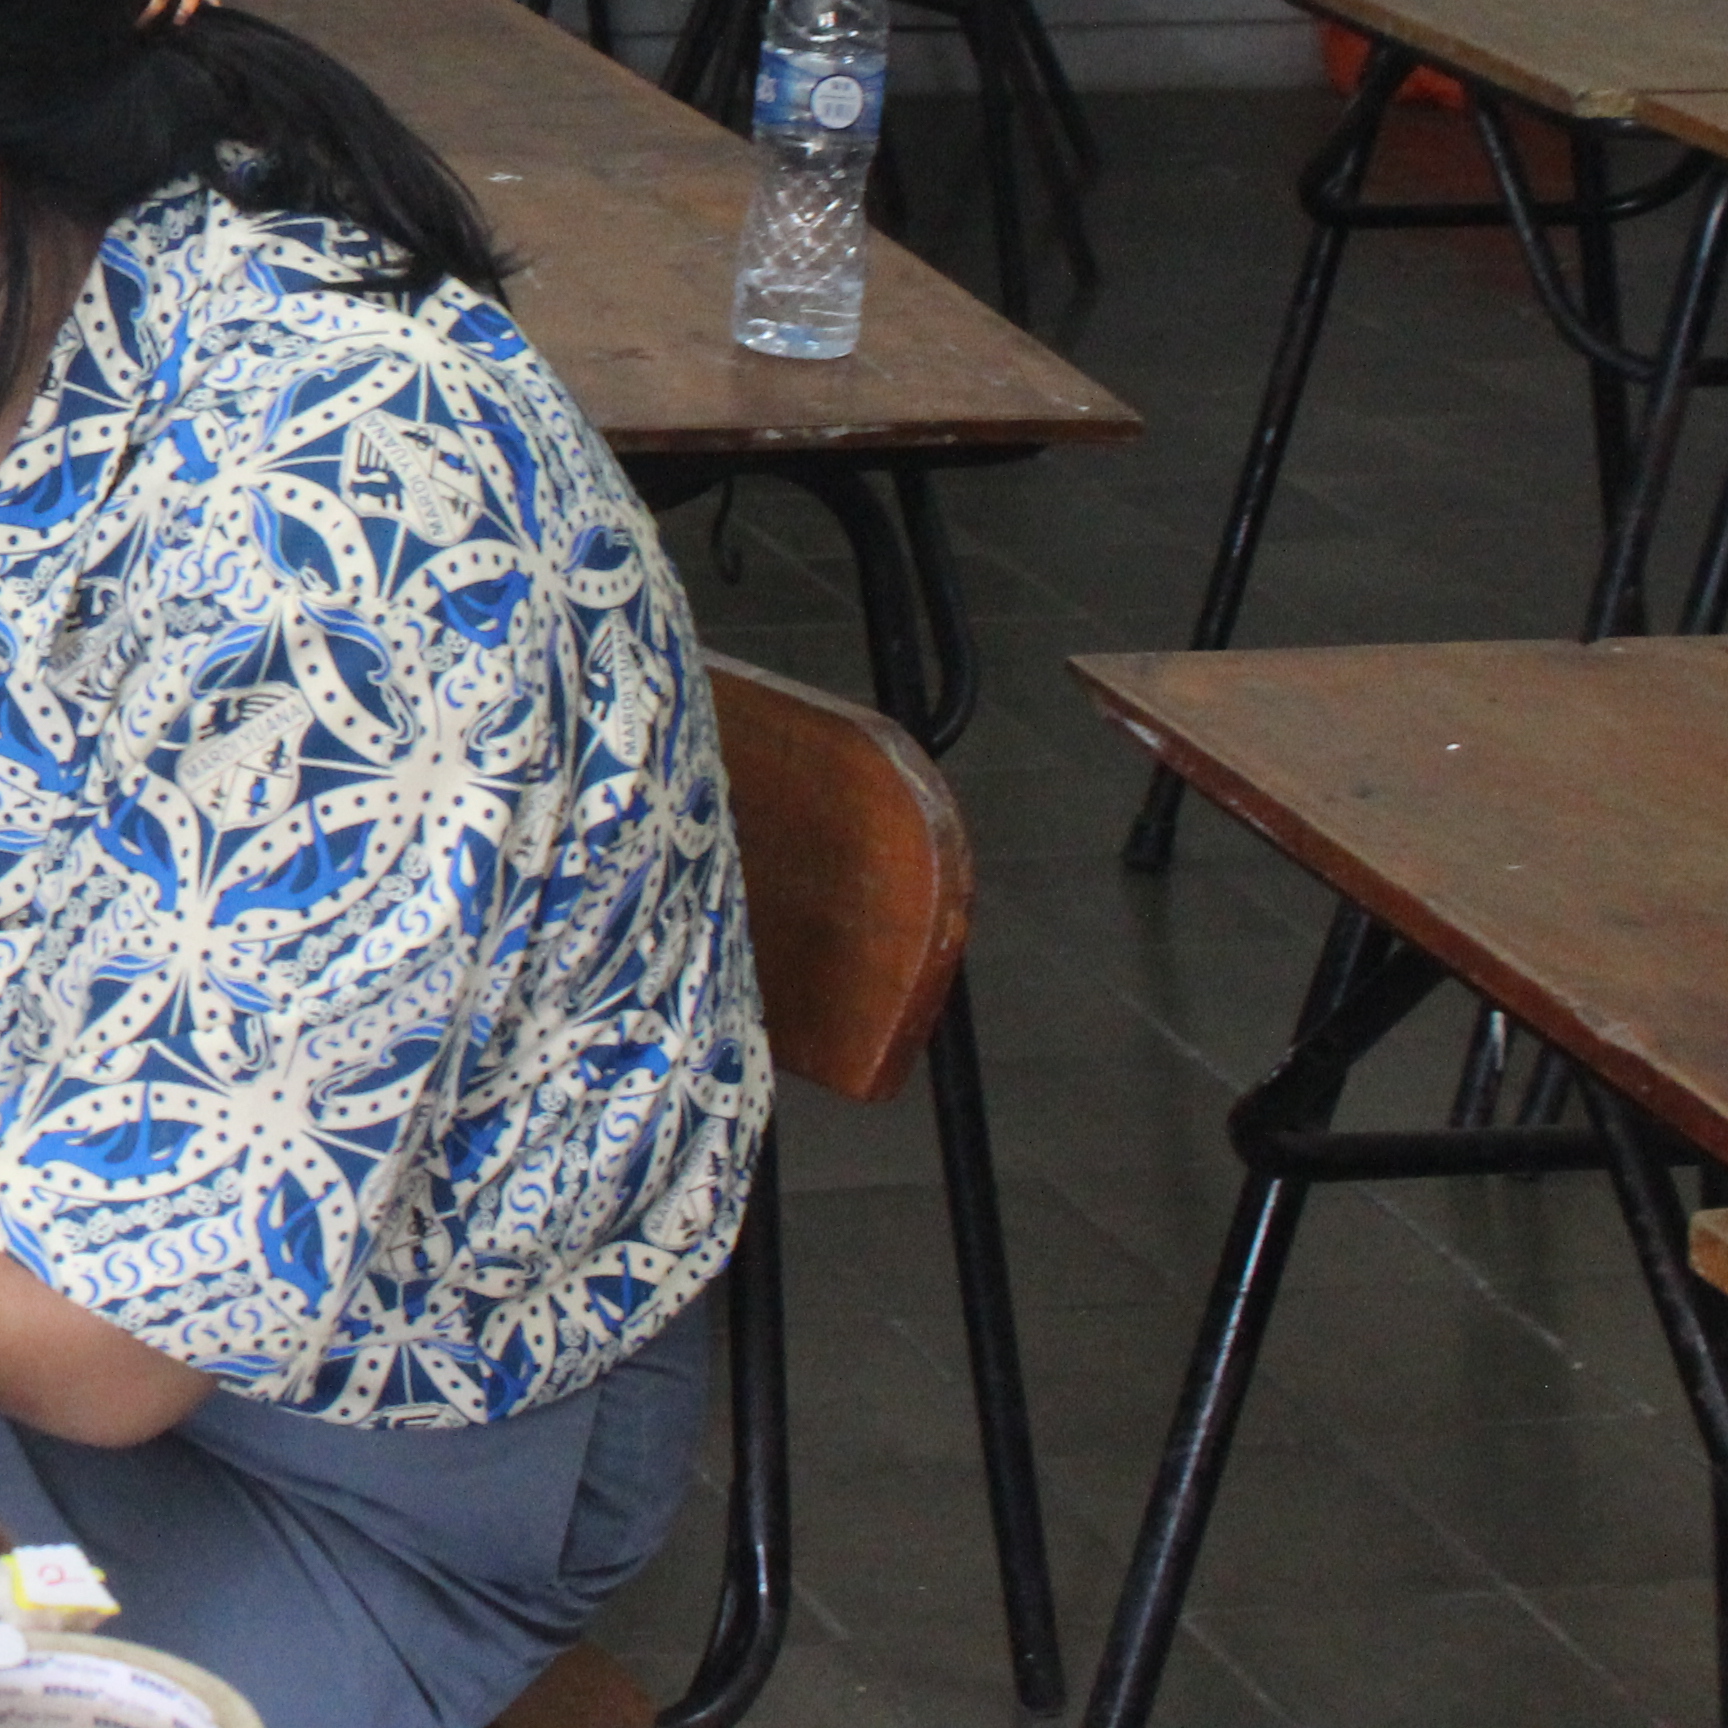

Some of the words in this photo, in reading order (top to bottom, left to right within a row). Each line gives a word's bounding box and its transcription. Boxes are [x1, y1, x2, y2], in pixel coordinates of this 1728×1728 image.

[365, 414, 412, 473] YUANA
[408, 474, 443, 537] MARDI
[184, 739, 241, 778] MARDI
[240, 704, 303, 742] YUANA
